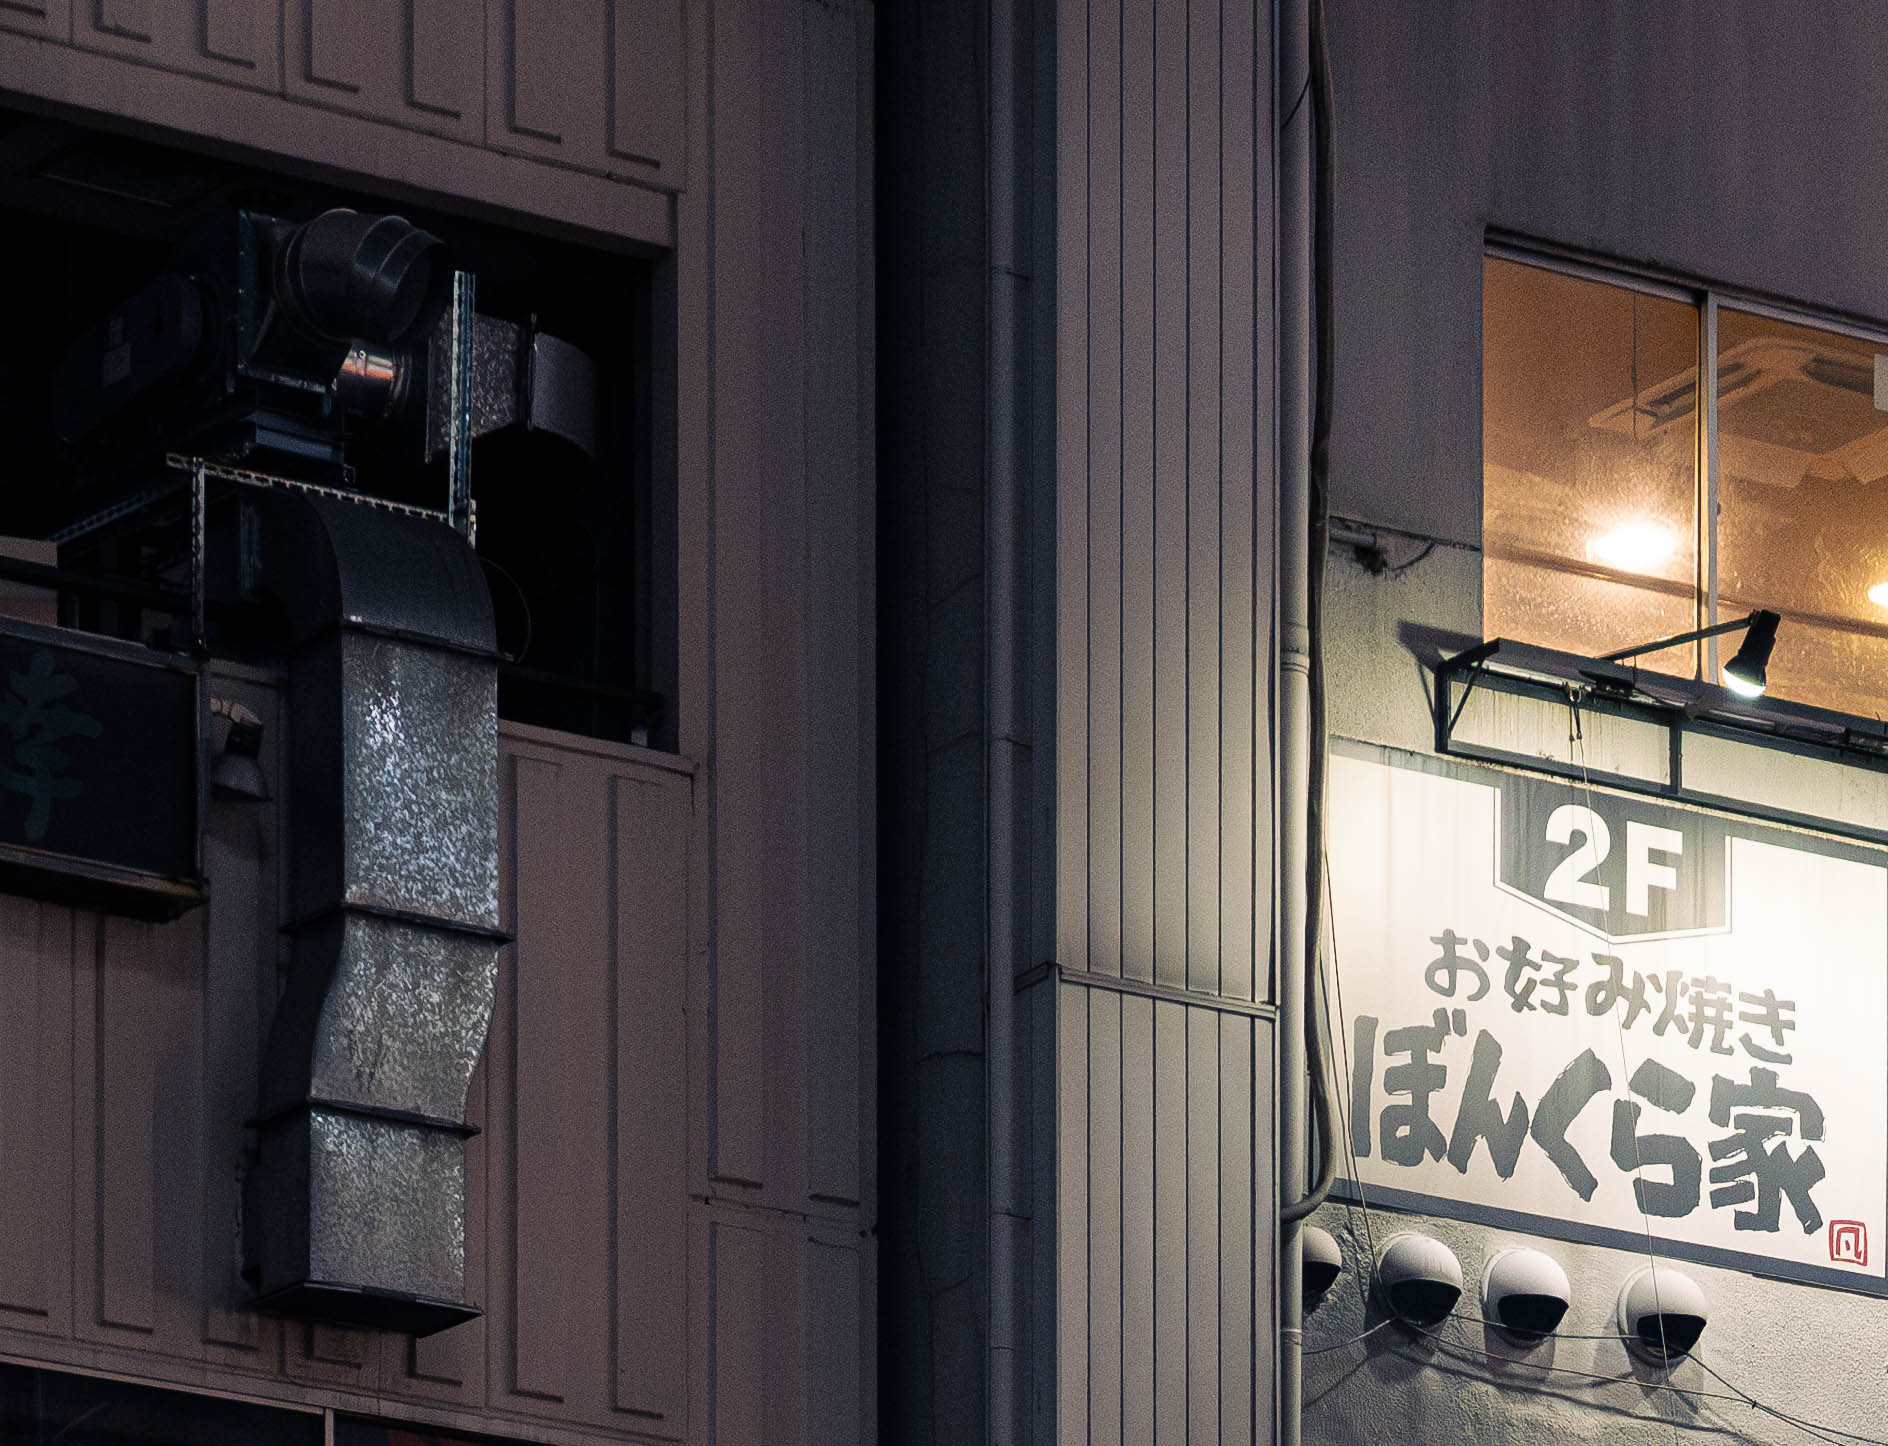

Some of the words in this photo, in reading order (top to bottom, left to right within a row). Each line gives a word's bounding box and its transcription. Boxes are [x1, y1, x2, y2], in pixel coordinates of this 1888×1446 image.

[1544, 801, 1689, 916] 2F
[1428, 927, 1797, 1063] お好み焼き
[1352, 1008, 1825, 1236] ぼんくら家
